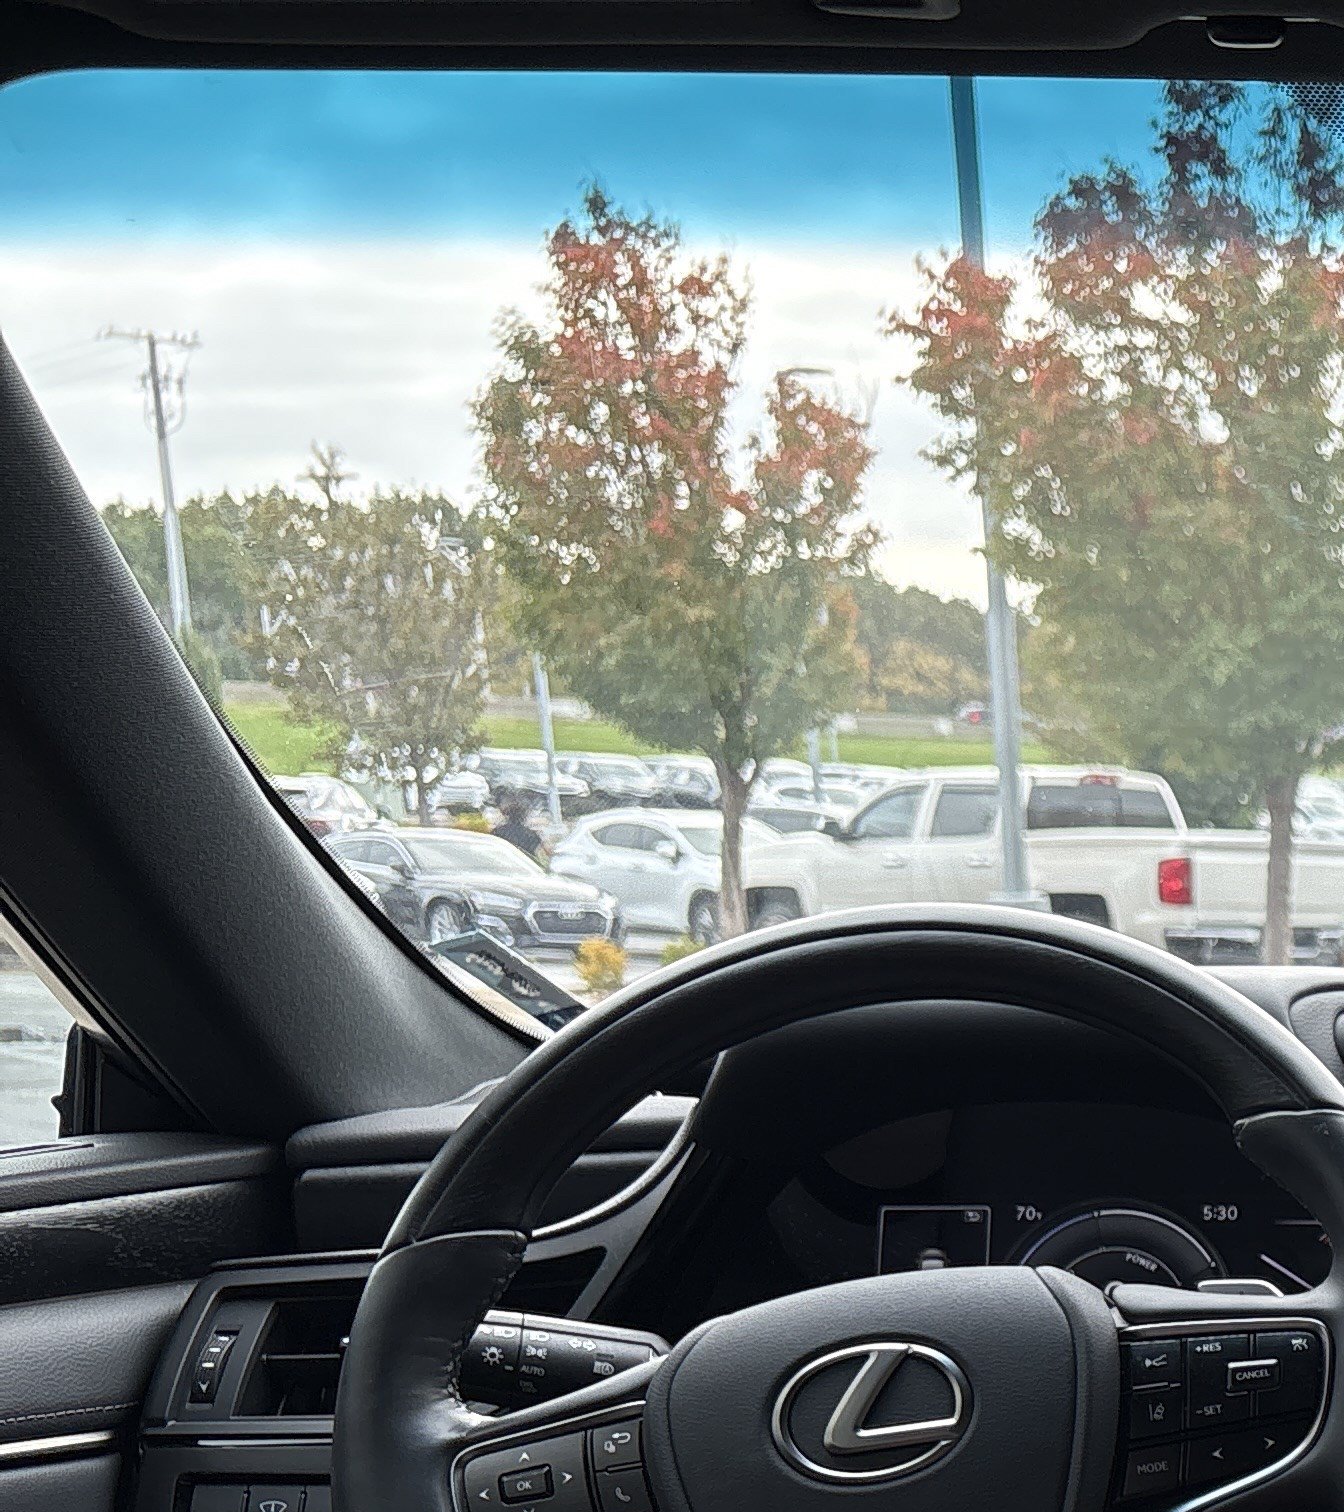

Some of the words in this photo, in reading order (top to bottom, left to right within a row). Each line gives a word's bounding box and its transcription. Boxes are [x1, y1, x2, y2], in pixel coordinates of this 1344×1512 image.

[1203, 1204, 1238, 1222] 5:30
[1125, 1252, 1158, 1272] POWER
[519, 1364, 546, 1378] AUTO
[1235, 1368, 1271, 1381] CANCEL
[1136, 1460, 1169, 1474] MODE
[515, 1479, 533, 1493] OK
